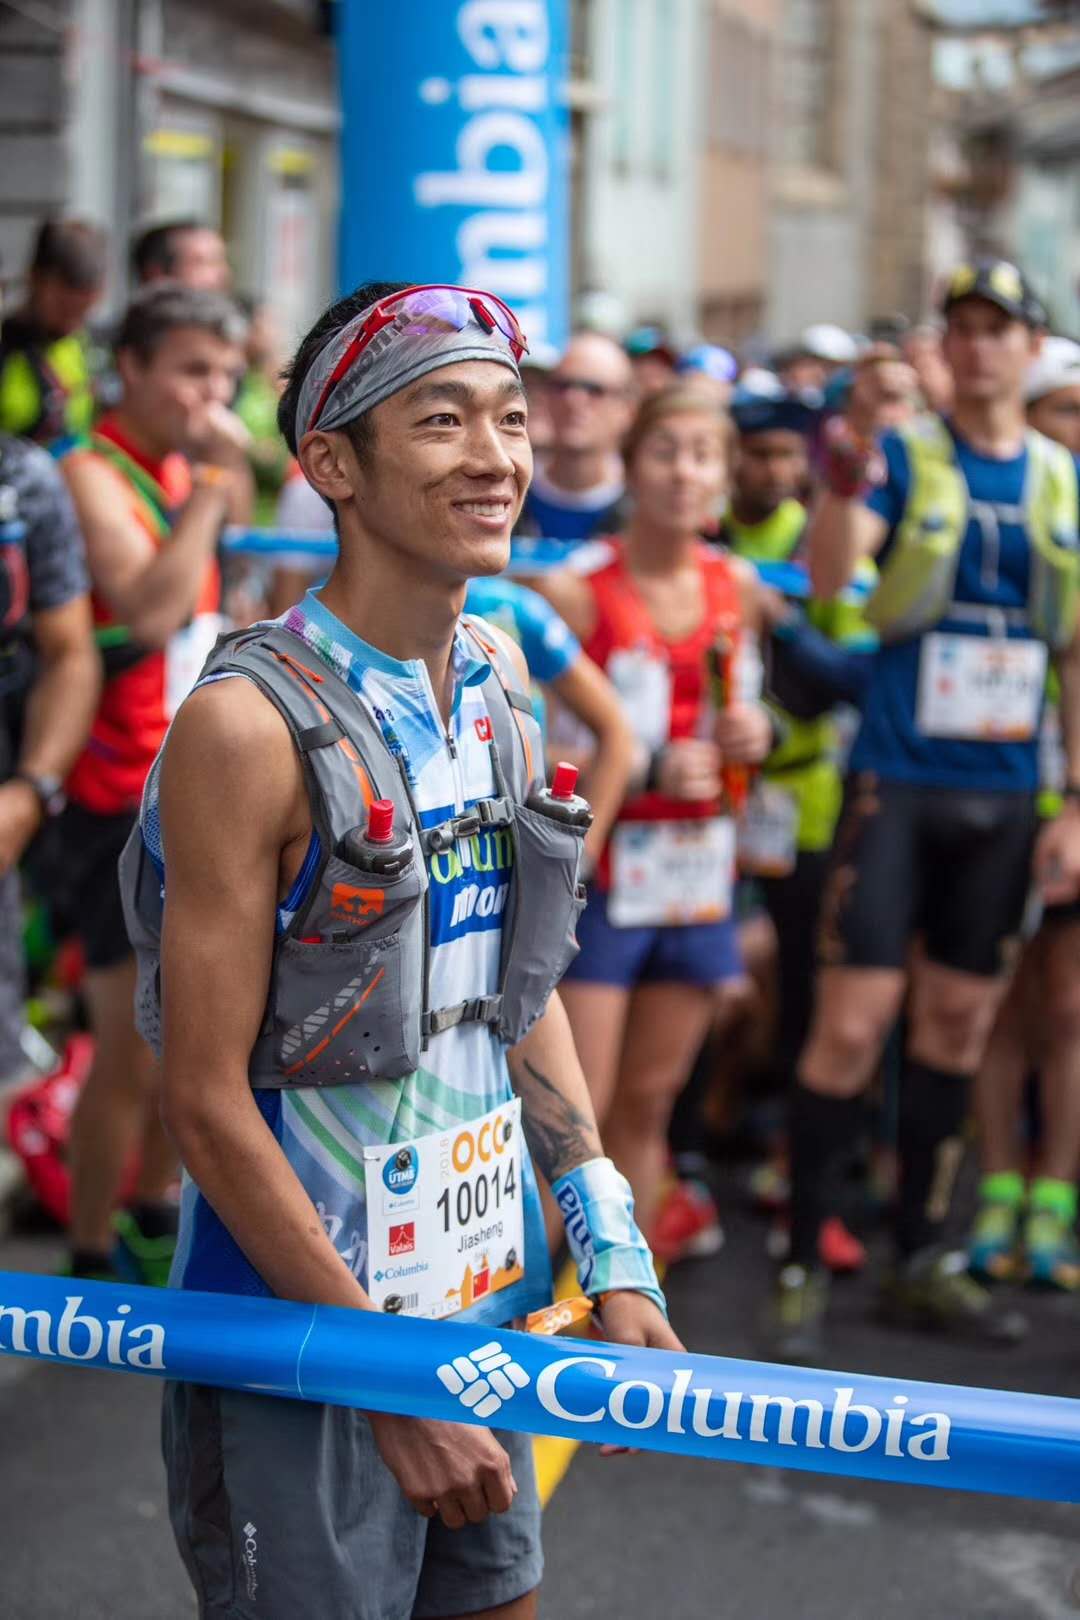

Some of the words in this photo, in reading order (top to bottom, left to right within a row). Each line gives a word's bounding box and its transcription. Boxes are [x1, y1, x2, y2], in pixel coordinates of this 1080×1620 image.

[413, 0, 549, 366] mbia
[452, 1115, 508, 1173] OCC
[436, 1157, 517, 1233] 10014
[384, 1261, 429, 1280] Columbia
[457, 1221, 504, 1253] Jiasheng
[536, 1356, 951, 1462] Columbia
